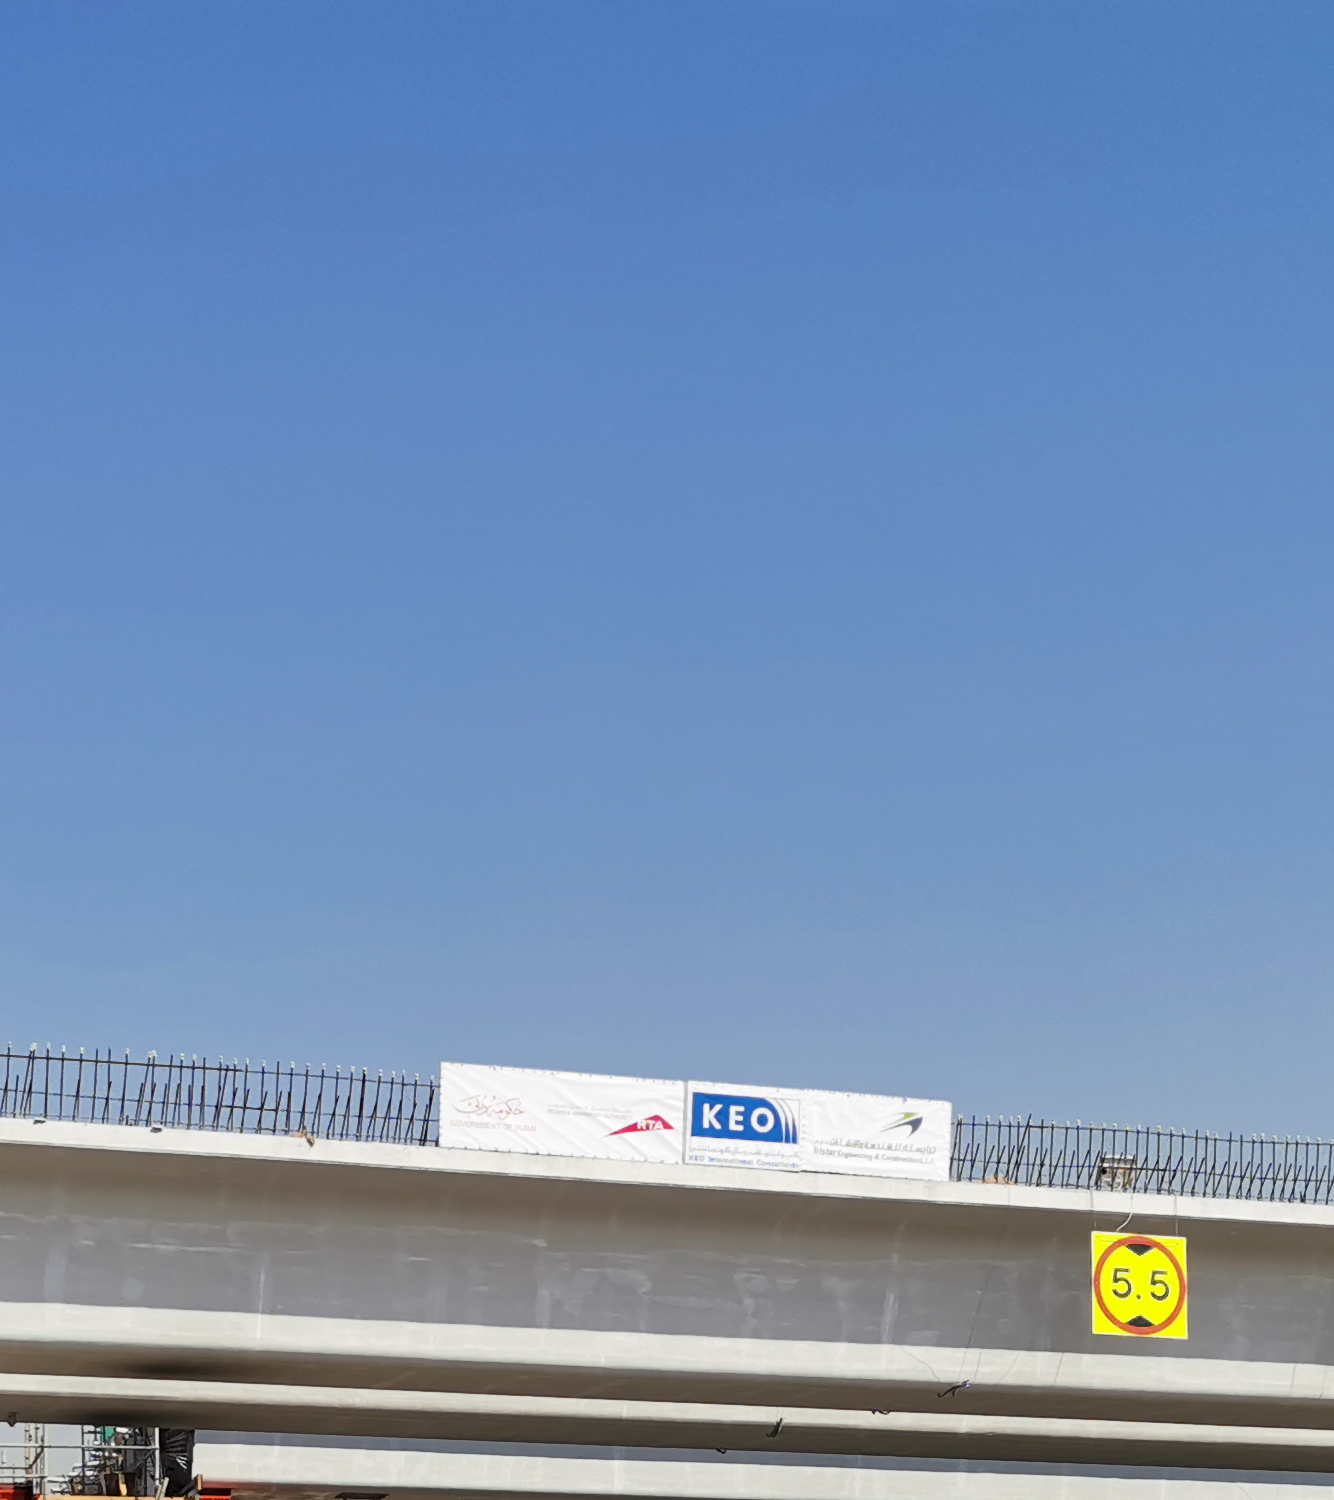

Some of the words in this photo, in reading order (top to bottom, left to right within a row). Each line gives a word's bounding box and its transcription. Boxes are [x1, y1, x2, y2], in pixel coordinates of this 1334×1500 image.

[636, 1119, 665, 1131] RTA
[702, 1103, 775, 1133] KEO
[689, 1155, 705, 1163] KEO
[1111, 1267, 1170, 1301] 5.5
